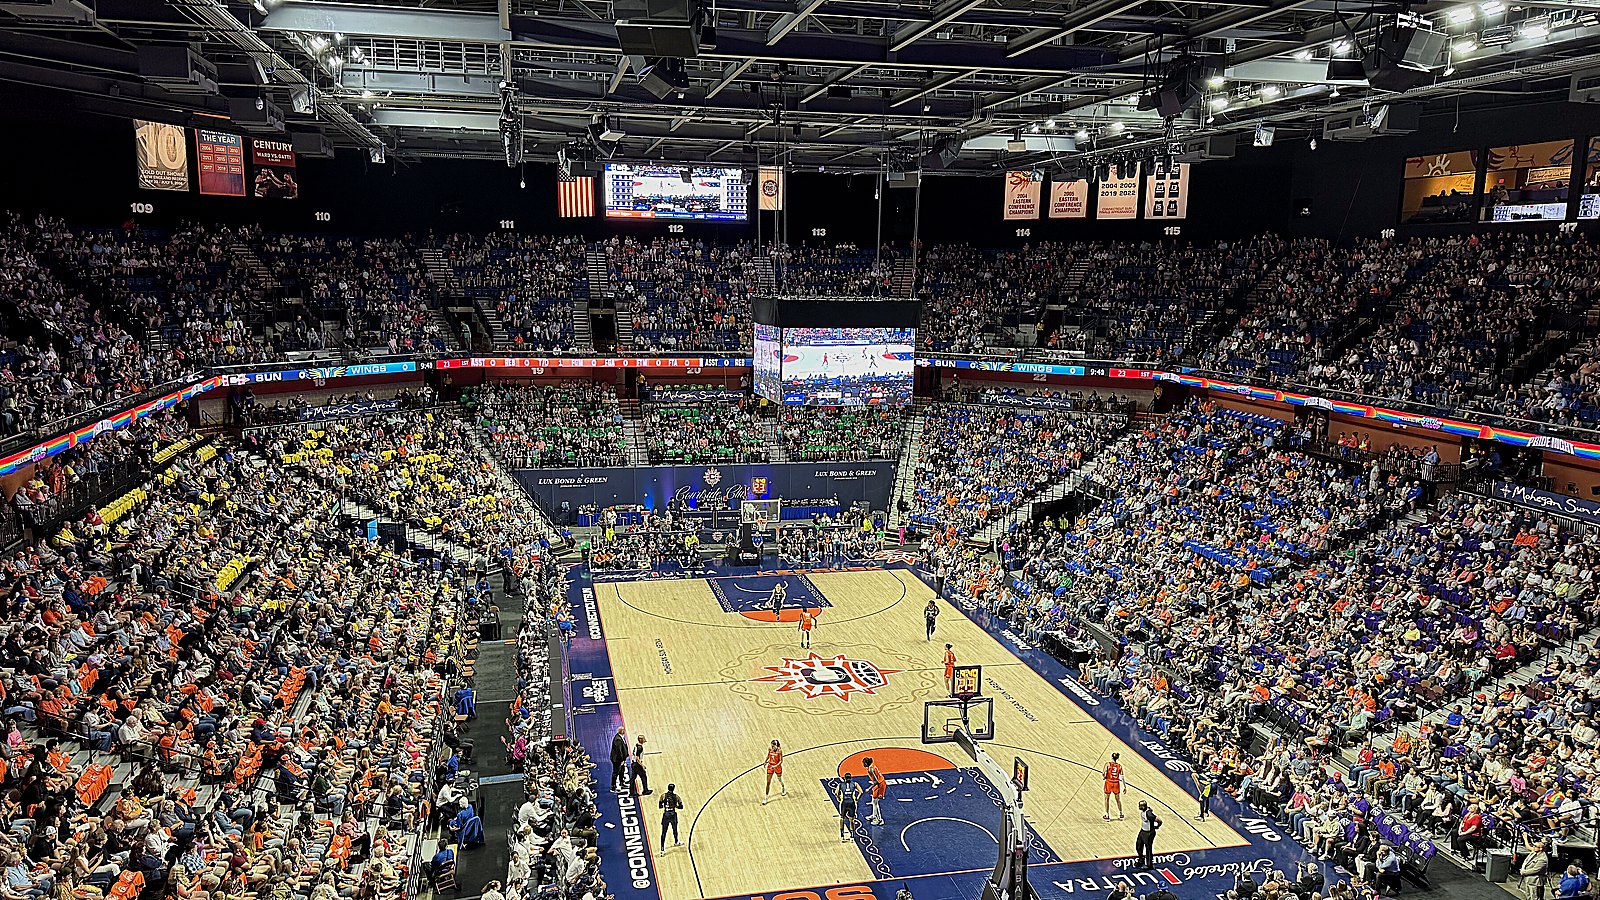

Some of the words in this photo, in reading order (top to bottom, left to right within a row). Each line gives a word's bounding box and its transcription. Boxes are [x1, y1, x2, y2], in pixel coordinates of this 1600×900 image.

[202, 134, 217, 143] THE
[218, 135, 236, 144] YEAR
[136, 124, 186, 170] 10
[253, 140, 293, 152] CENTURY
[130, 202, 154, 214] 109
[315, 212, 331, 221] 110
[500, 220, 514, 228] 111
[668, 225, 684, 233] 112
[1559, 222, 1578, 232] 117
[811, 228, 827, 236] 113
[1015, 228, 1031, 237] 114
[1163, 226, 1181, 235] 115
[489, 359, 496, 367] 0
[523, 359, 530, 367] 0
[558, 359, 563, 367] 1
[591, 359, 597, 367] 0
[622, 359, 629, 367] 0
[655, 359, 662, 367] 0
[684, 359, 690, 367] 0
[723, 359, 730, 367] 0
[350, 366, 387, 375] WINGS
[1017, 365, 1053, 373] WINGS
[1069, 367, 1076, 375] 0
[1033, 373, 1047, 381] 22
[662, 390, 698, 400] Mohegan
[699, 390, 717, 399] Sun
[717, 390, 744, 399] Arena
[989, 394, 1025, 405] Mohegan
[1025, 397, 1042, 406] Sun
[1043, 398, 1071, 408] Arena
[314, 405, 351, 417] Mohegan
[352, 403, 369, 414] Sun
[370, 401, 397, 411] Arena
[1526, 436, 1551, 448] PRIDE
[1550, 436, 1575, 455] NIGHT
[753, 483, 766, 491] 23
[675, 485, 722, 501] Courtside
[1511, 486, 1562, 510] Mohegan
[1564, 498, 1591, 514] Sun
[583, 686, 593, 697] NO
[591, 680, 605, 702] SPACE
[1139, 740, 1176, 760] AT&T
[1112, 766, 1118, 774] 3
[1240, 816, 1282, 842] ally
[1112, 853, 1191, 868] Courside
[1183, 857, 1274, 882] Michelob
